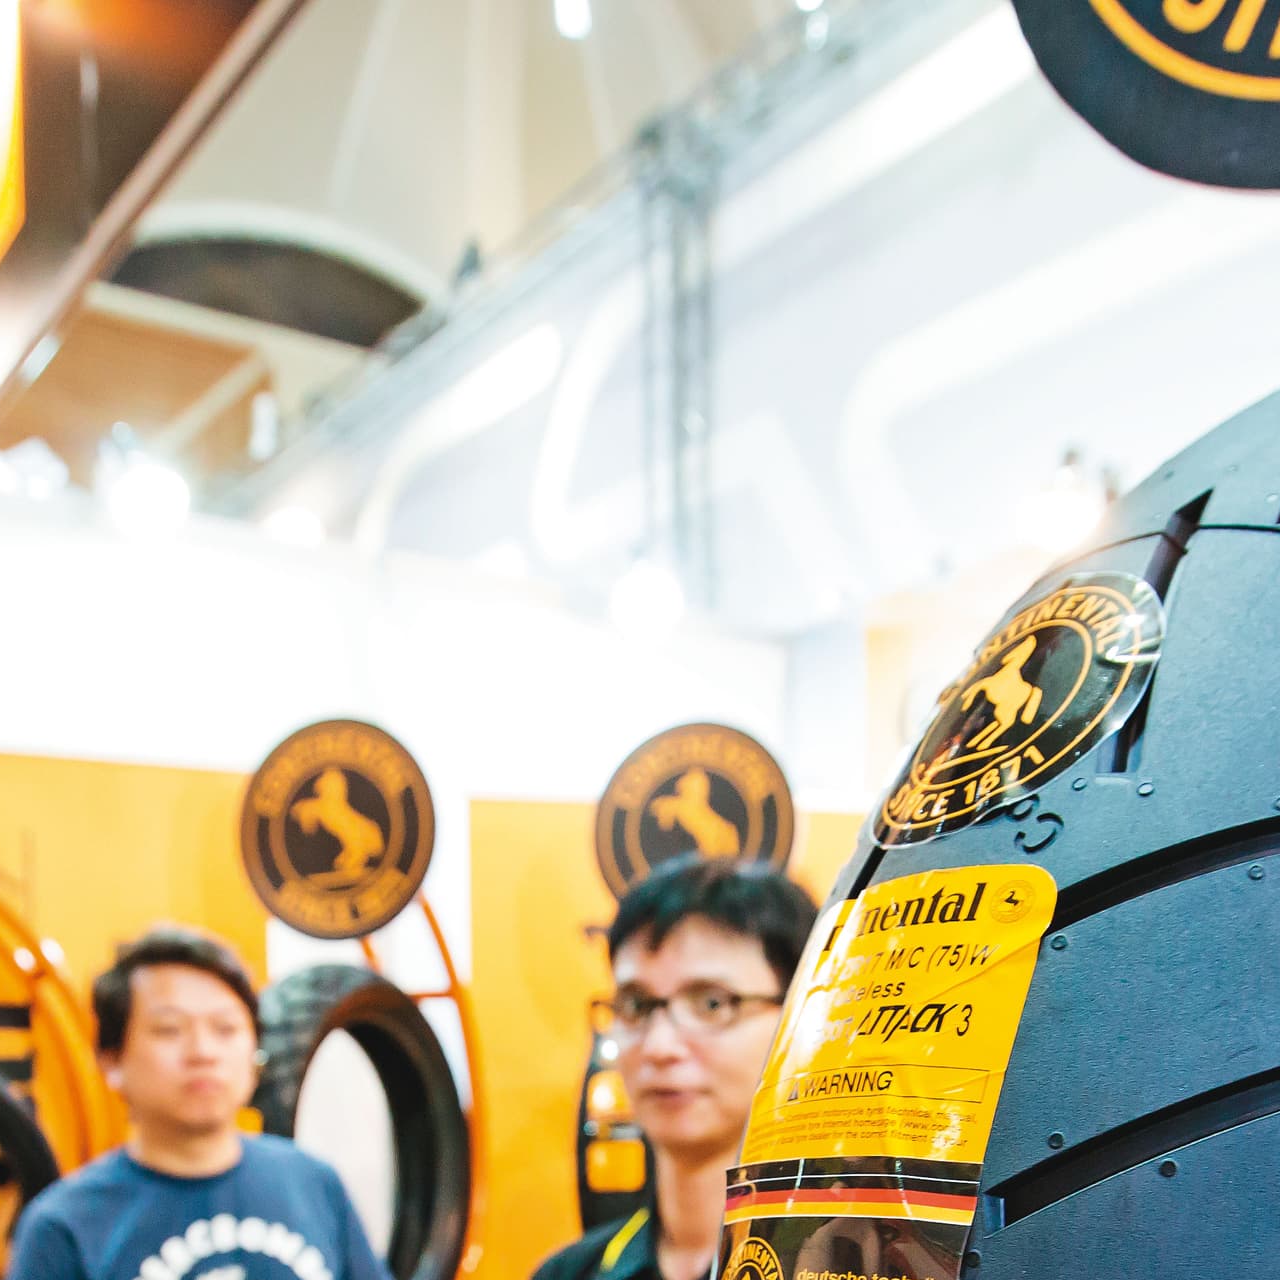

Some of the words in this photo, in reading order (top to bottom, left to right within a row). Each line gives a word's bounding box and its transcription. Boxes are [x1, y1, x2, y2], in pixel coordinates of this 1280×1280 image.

[964, 745, 1045, 805] 1871
[884, 946, 924, 971] M/C
[927, 944, 1000, 973] (75)W
[956, 1004, 973, 1036] 3
[804, 1071, 893, 1098] WARNING
